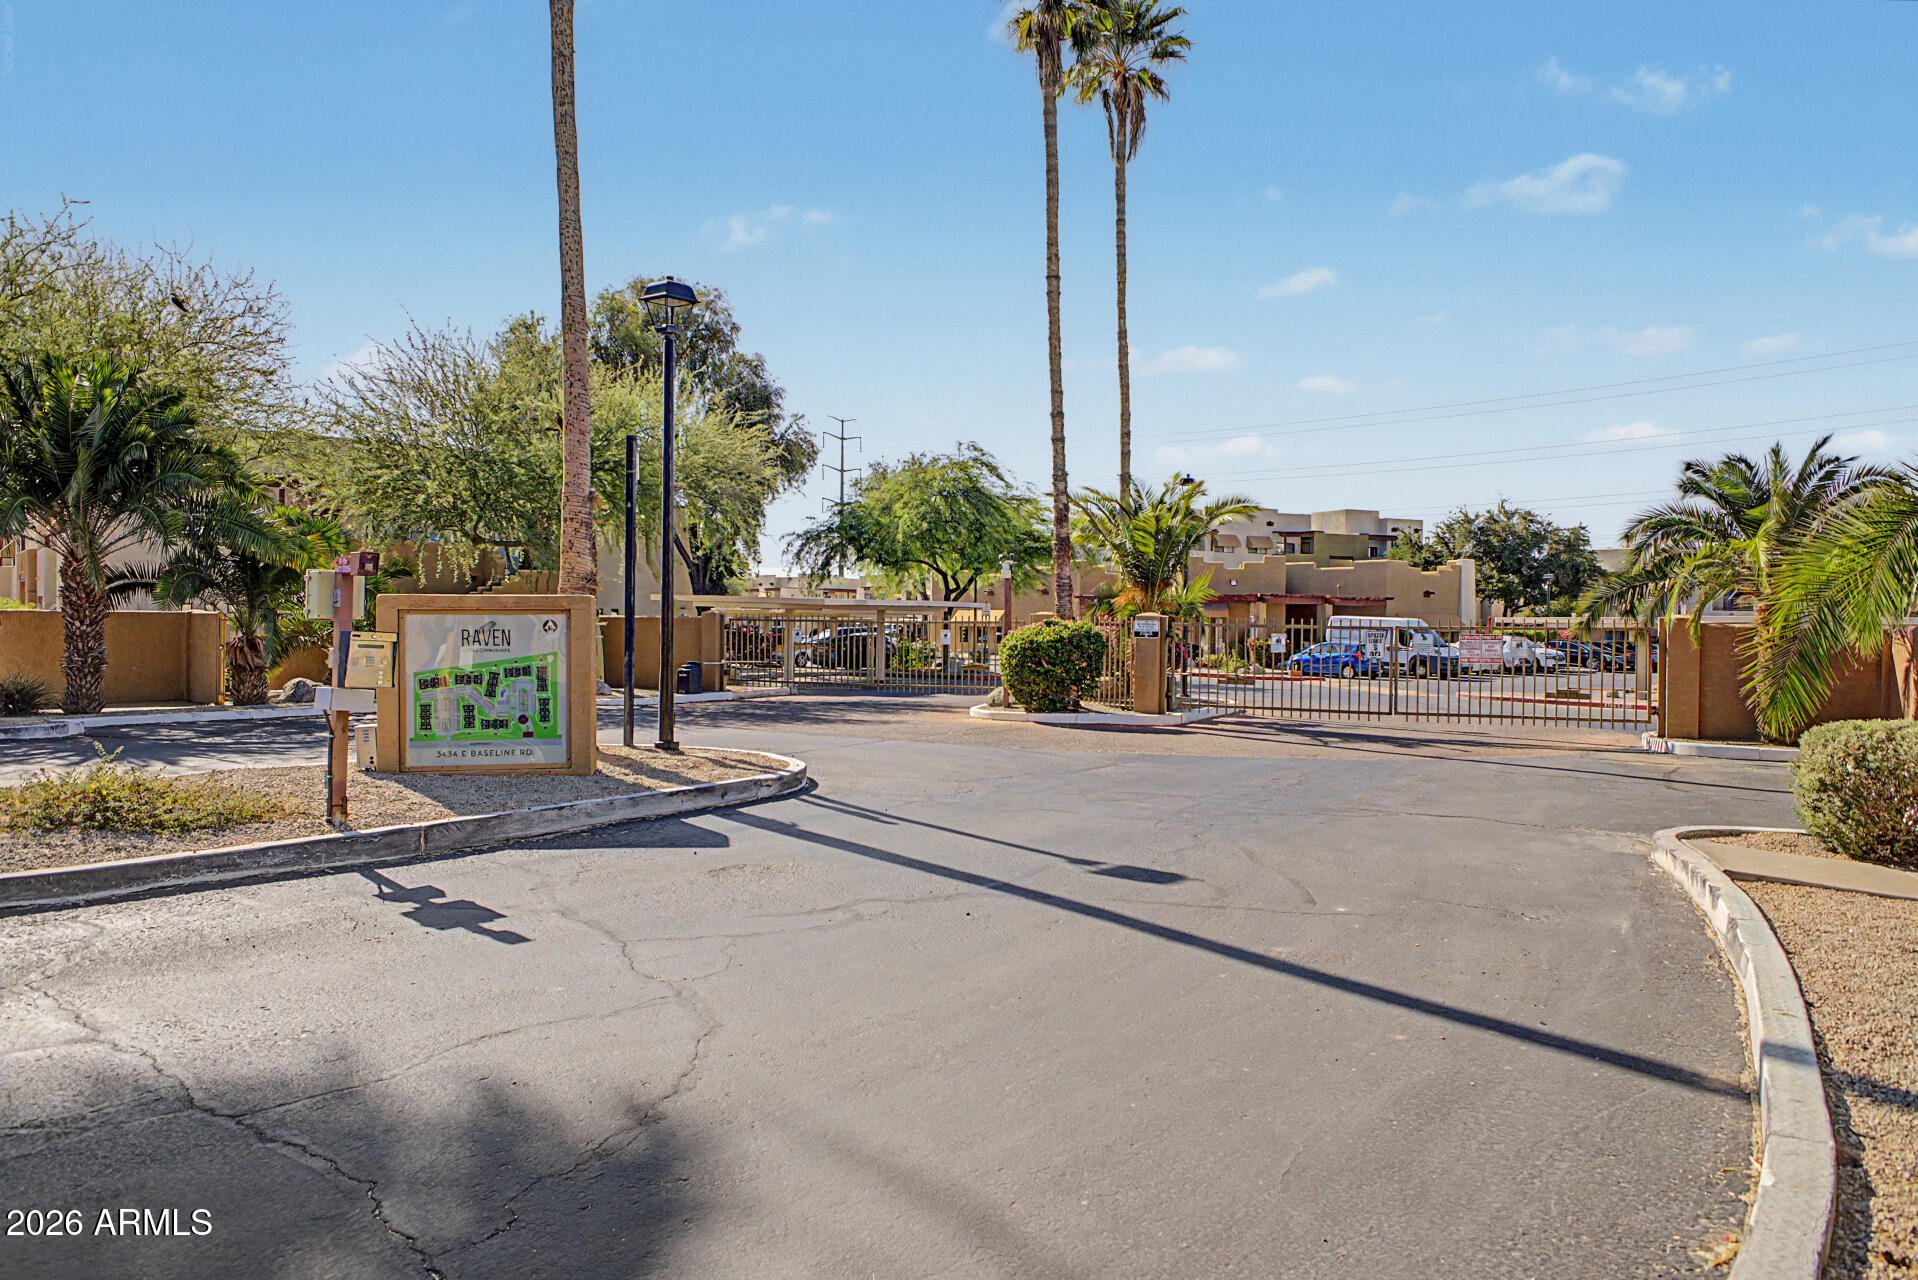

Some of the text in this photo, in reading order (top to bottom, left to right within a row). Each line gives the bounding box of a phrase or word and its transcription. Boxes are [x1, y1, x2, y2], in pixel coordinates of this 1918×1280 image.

[461, 629, 511, 646] RAVEN
[436, 750, 458, 758] 3434
[470, 749, 516, 757] BASELINE
